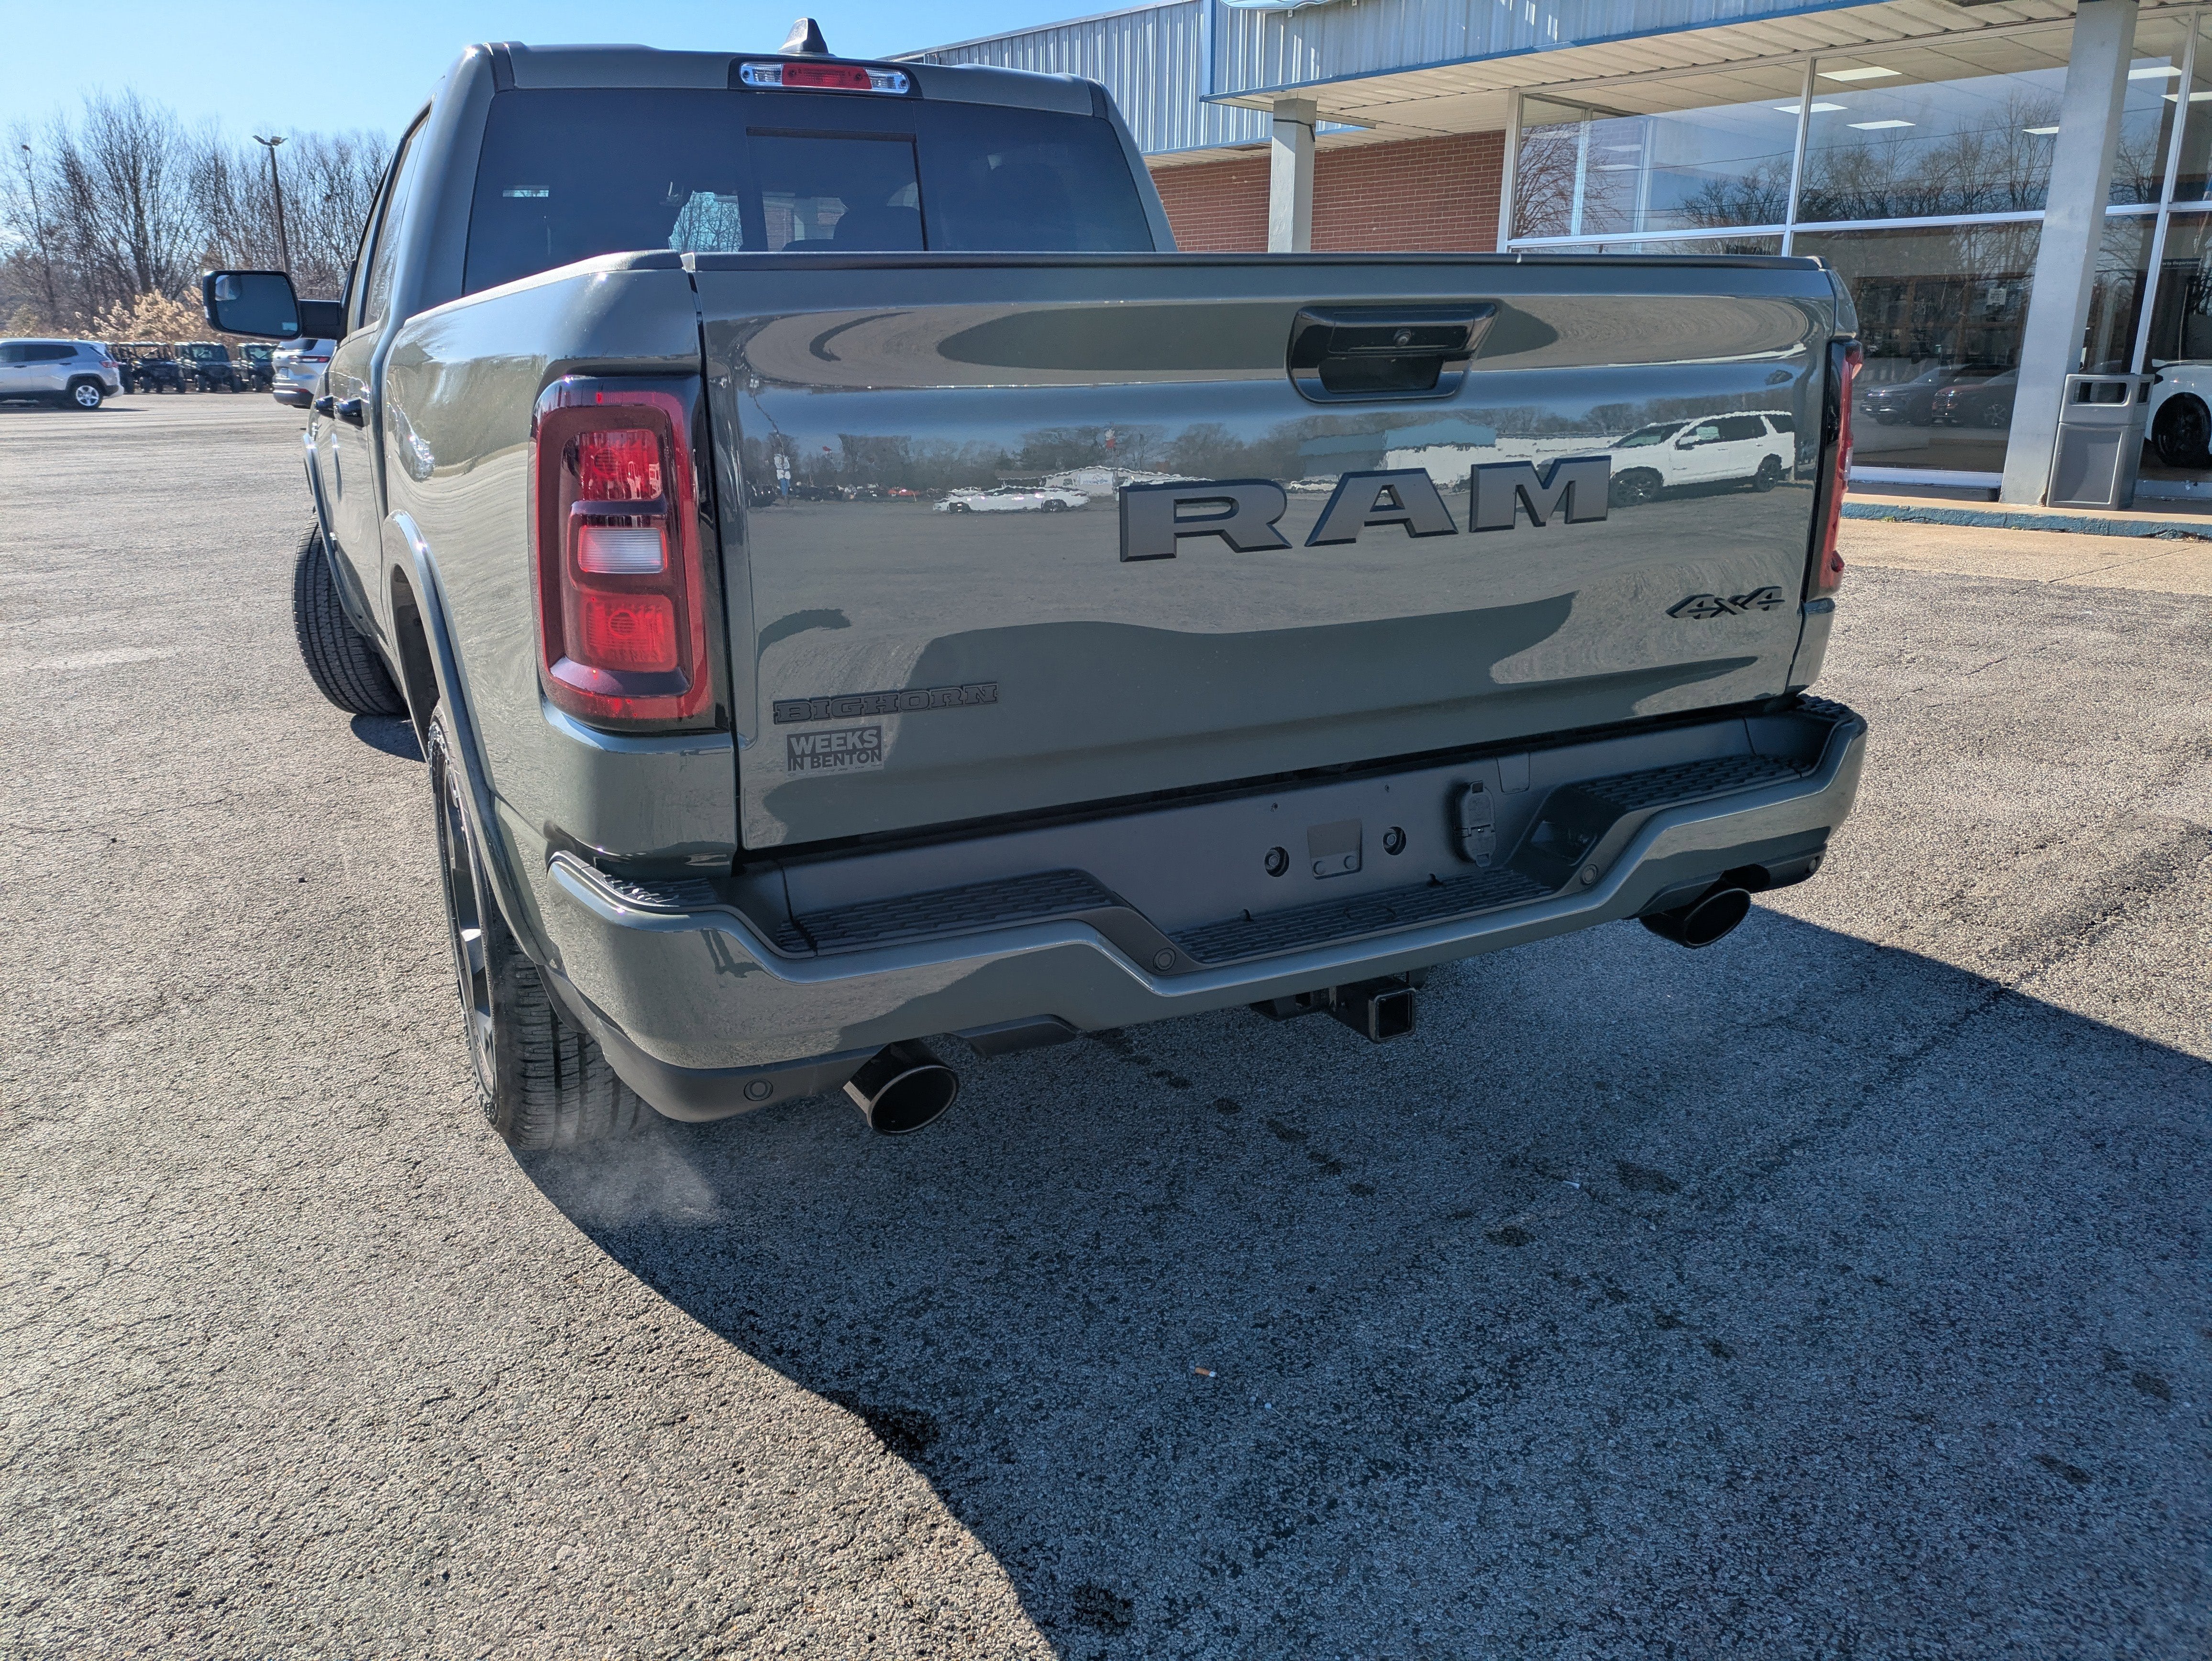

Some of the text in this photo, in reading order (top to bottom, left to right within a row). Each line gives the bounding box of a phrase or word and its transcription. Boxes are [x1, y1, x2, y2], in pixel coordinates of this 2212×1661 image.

[1119, 455, 1612, 562] RAM
[773, 682, 998, 725] BIGHORN
[787, 748, 882, 772] IN BENTON
[790, 729, 878, 756] WEEKS
